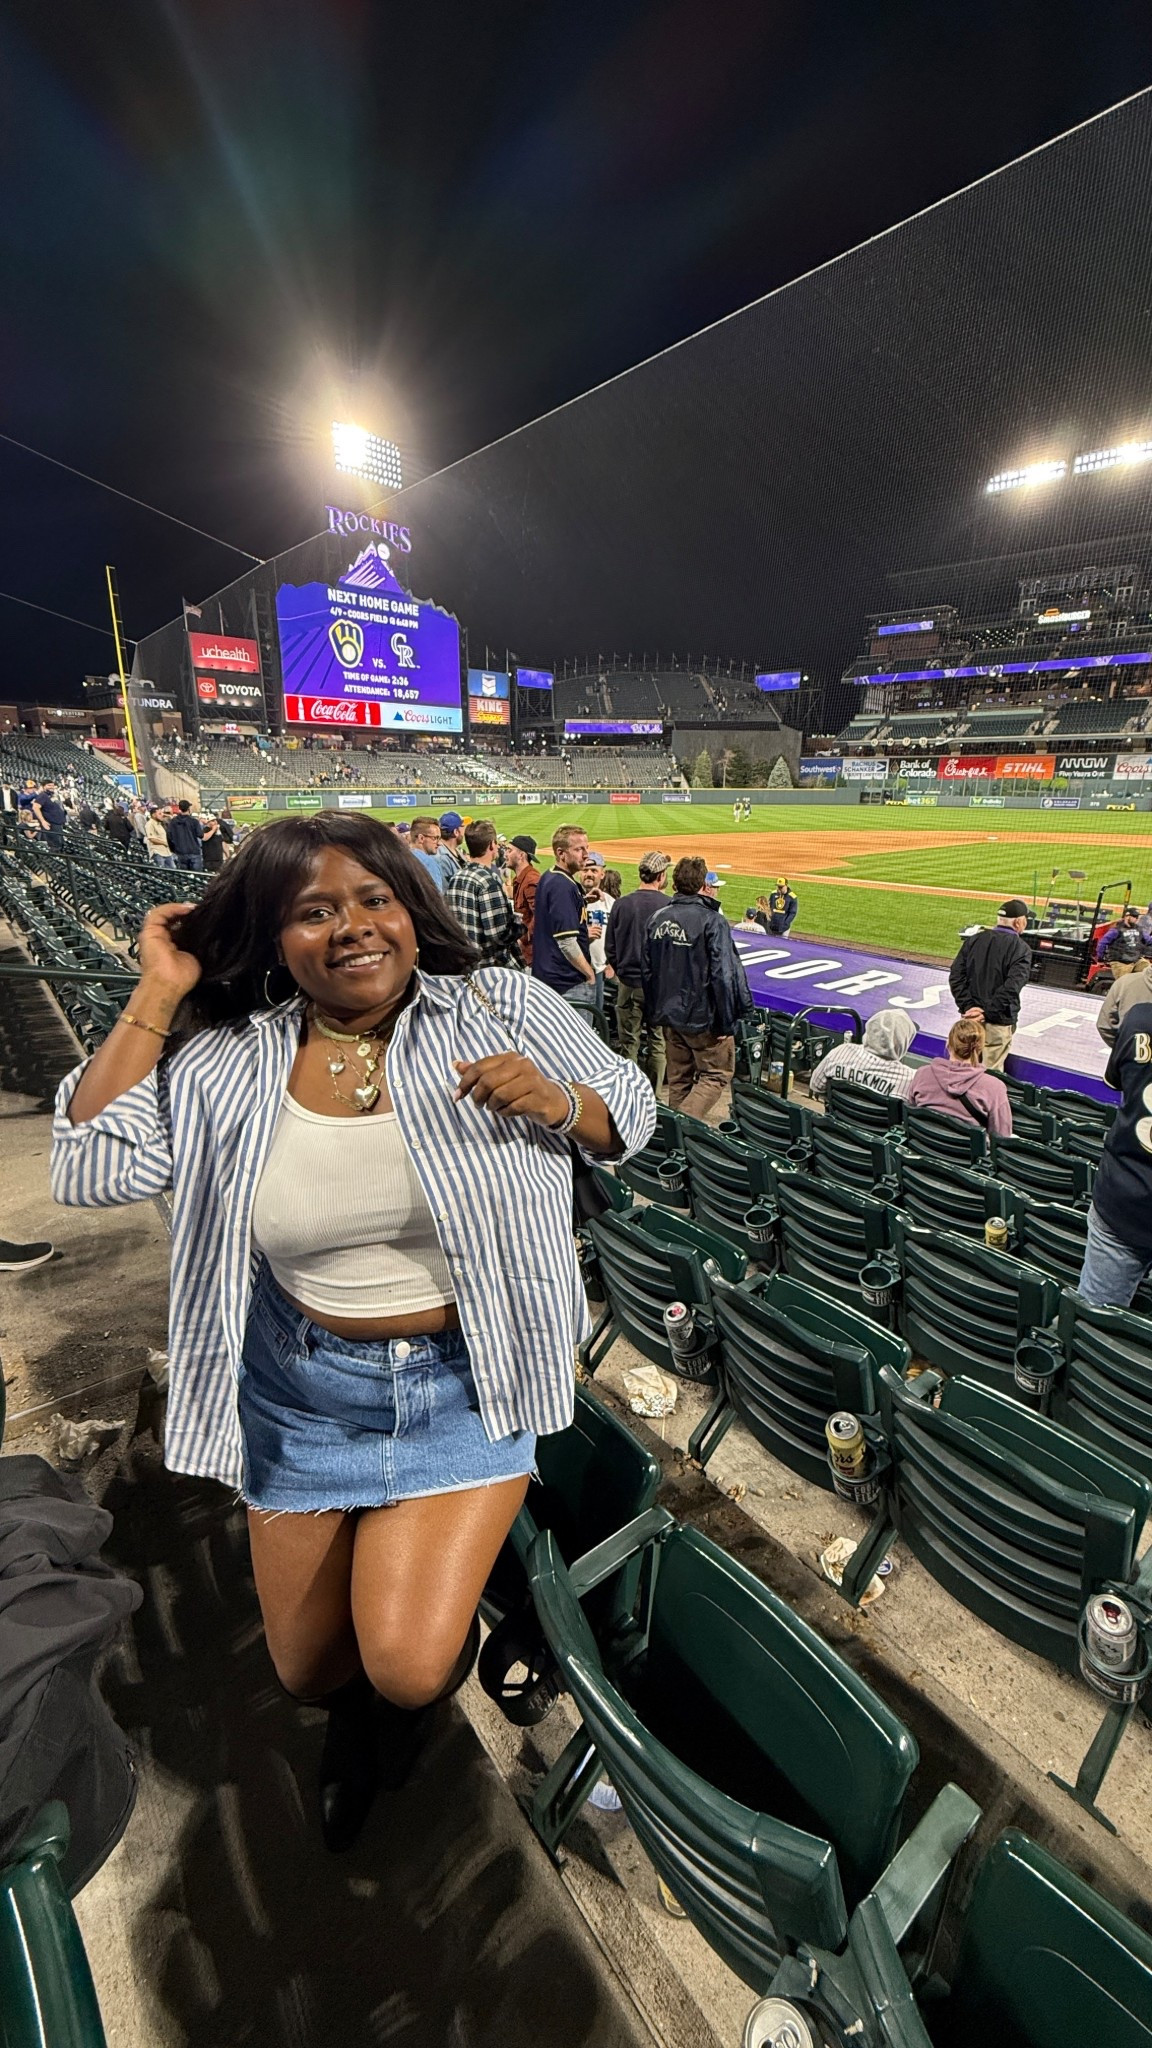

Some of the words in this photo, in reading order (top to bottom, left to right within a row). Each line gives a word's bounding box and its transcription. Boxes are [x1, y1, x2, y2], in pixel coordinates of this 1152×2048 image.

[325, 505, 412, 553] ROCKIES
[327, 588, 357, 605] NEXT
[359, 594, 389, 611] HOME
[391, 600, 419, 616] GAME
[330, 606, 343, 616] 4/9
[347, 609, 369, 621] COORS
[369, 613, 388, 624] FIELD
[409, 620, 419, 630] PM
[201, 644, 250, 662] uchealth
[372, 657, 387, 669] VS.
[343, 671, 360, 681] TIME
[361, 673, 370, 682] OF
[370, 674, 391, 684] GAME:
[391, 675, 409, 686] 2:36
[219, 683, 262, 697] TOYOTA
[344, 684, 390, 696] ATTENDANCE:
[393, 688, 419, 700] 18,657
[132, 697, 174, 709] TUNDRA
[476, 699, 503, 713] KING
[310, 700, 358, 722] Coca-Cola
[404, 709, 429, 724] Coors
[430, 716, 452, 725] LIGHT
[800, 764, 837, 774] Southwest
[900, 760, 920, 769] Bank
[921, 760, 931, 769] of
[1002, 763, 1046, 773] STIHL
[1060, 758, 1108, 768] ARROW
[1116, 762, 1149, 774] Coors
[900, 768, 937, 778] Colorado
[654, 927, 687, 941] ALASKA
[734, 942, 951, 1008] OORS
[835, 1065, 896, 1096] BLACKMON
